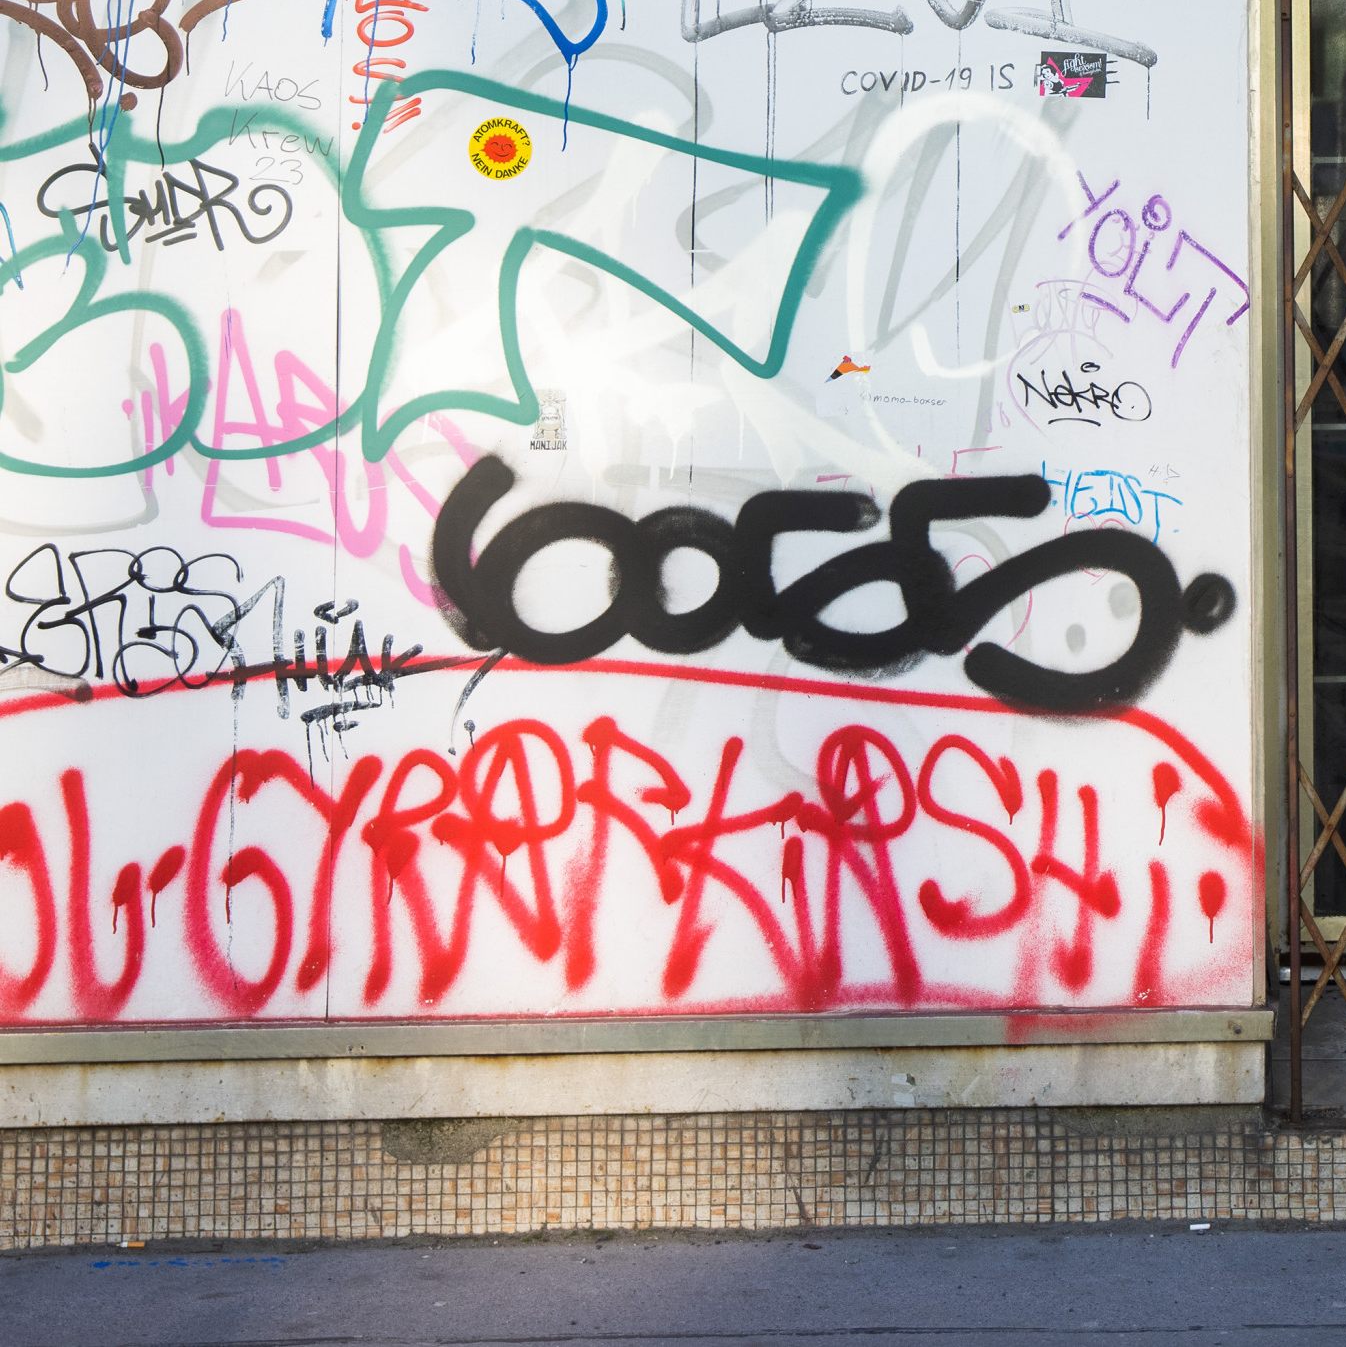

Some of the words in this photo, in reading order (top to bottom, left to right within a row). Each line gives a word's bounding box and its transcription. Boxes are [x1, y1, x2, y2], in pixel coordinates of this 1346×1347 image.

[225, 59, 322, 110] KAOS
[841, 64, 973, 95] COVID-19
[990, 63, 1015, 90] IS
[228, 108, 335, 157] Krew
[473, 118, 531, 147] ATOMKRAFT?
[249, 156, 304, 185] 23
[471, 152, 493, 176] NEIN
[495, 156, 529, 179] DANKE
